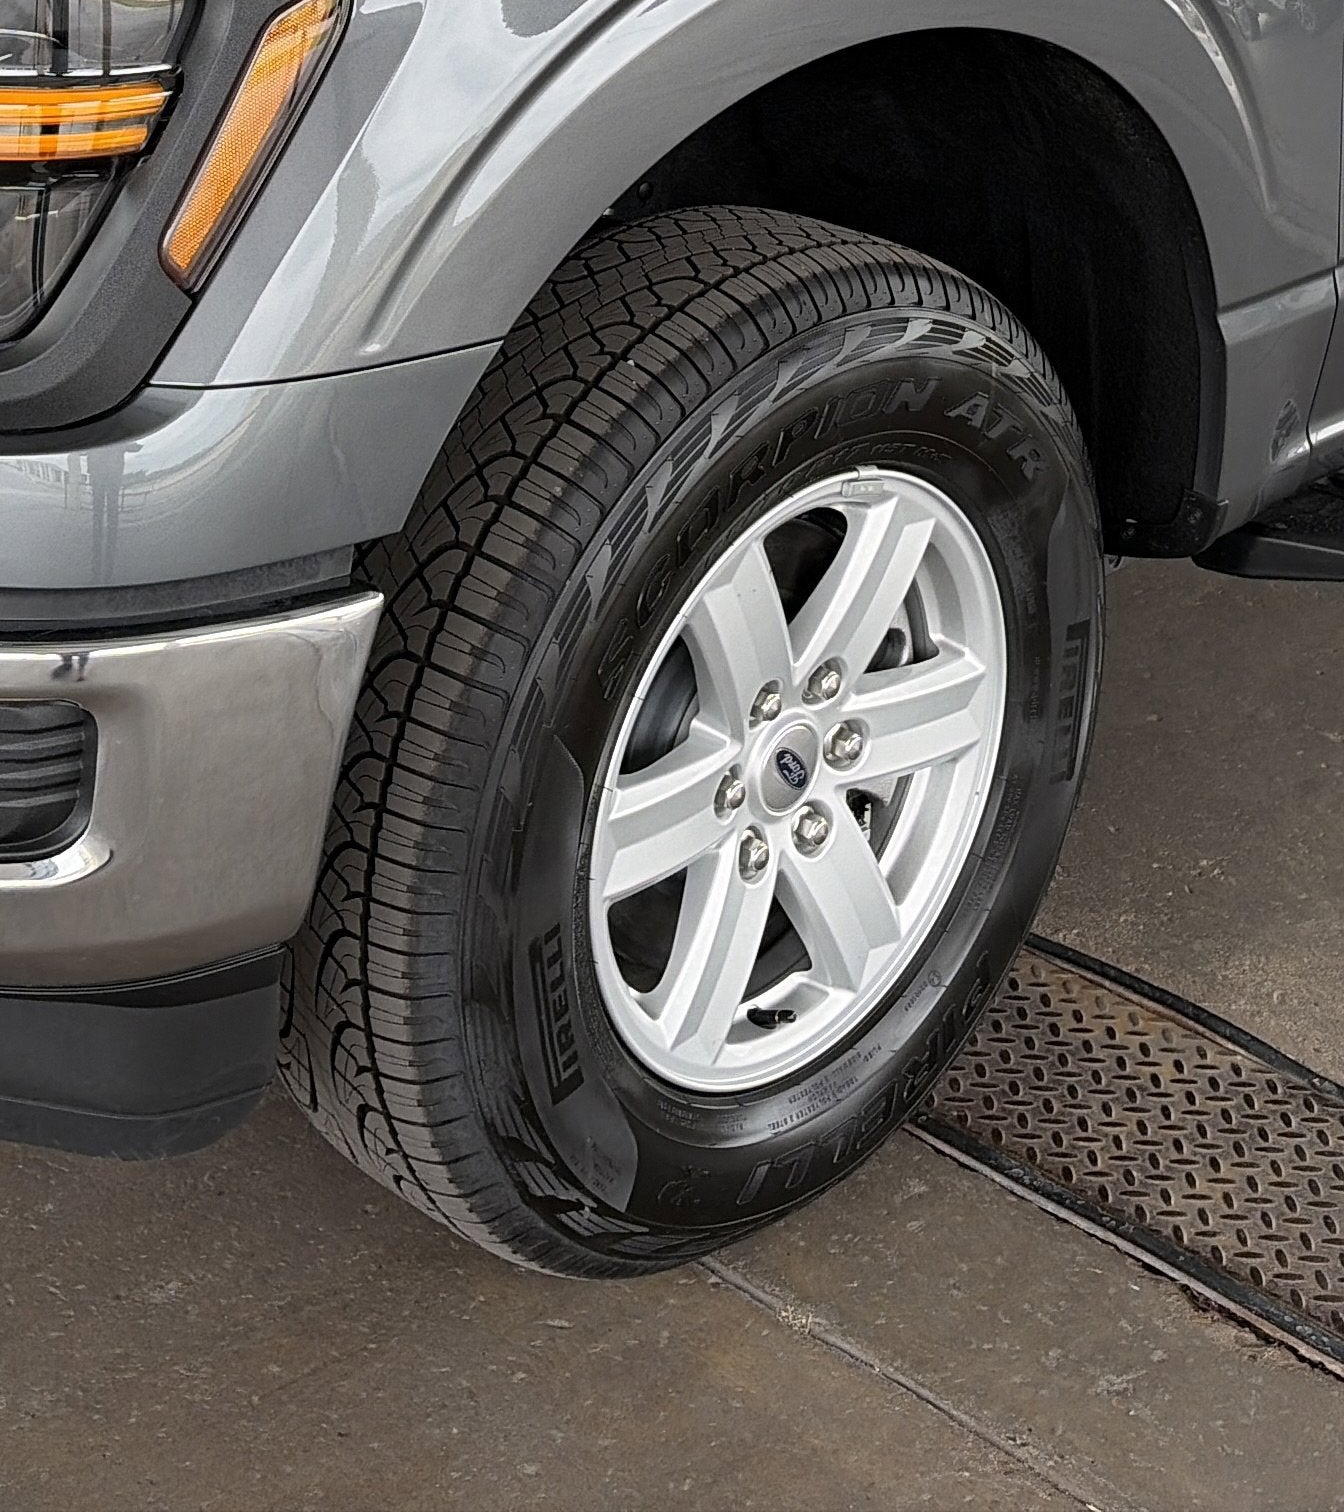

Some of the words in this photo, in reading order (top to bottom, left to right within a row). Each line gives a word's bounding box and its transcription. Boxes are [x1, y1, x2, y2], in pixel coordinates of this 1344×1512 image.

[597, 376, 941, 701] SCORPION
[945, 391, 1048, 481] ATR
[779, 753, 805, 785] Ford
[529, 922, 585, 1105] PIRELLI
